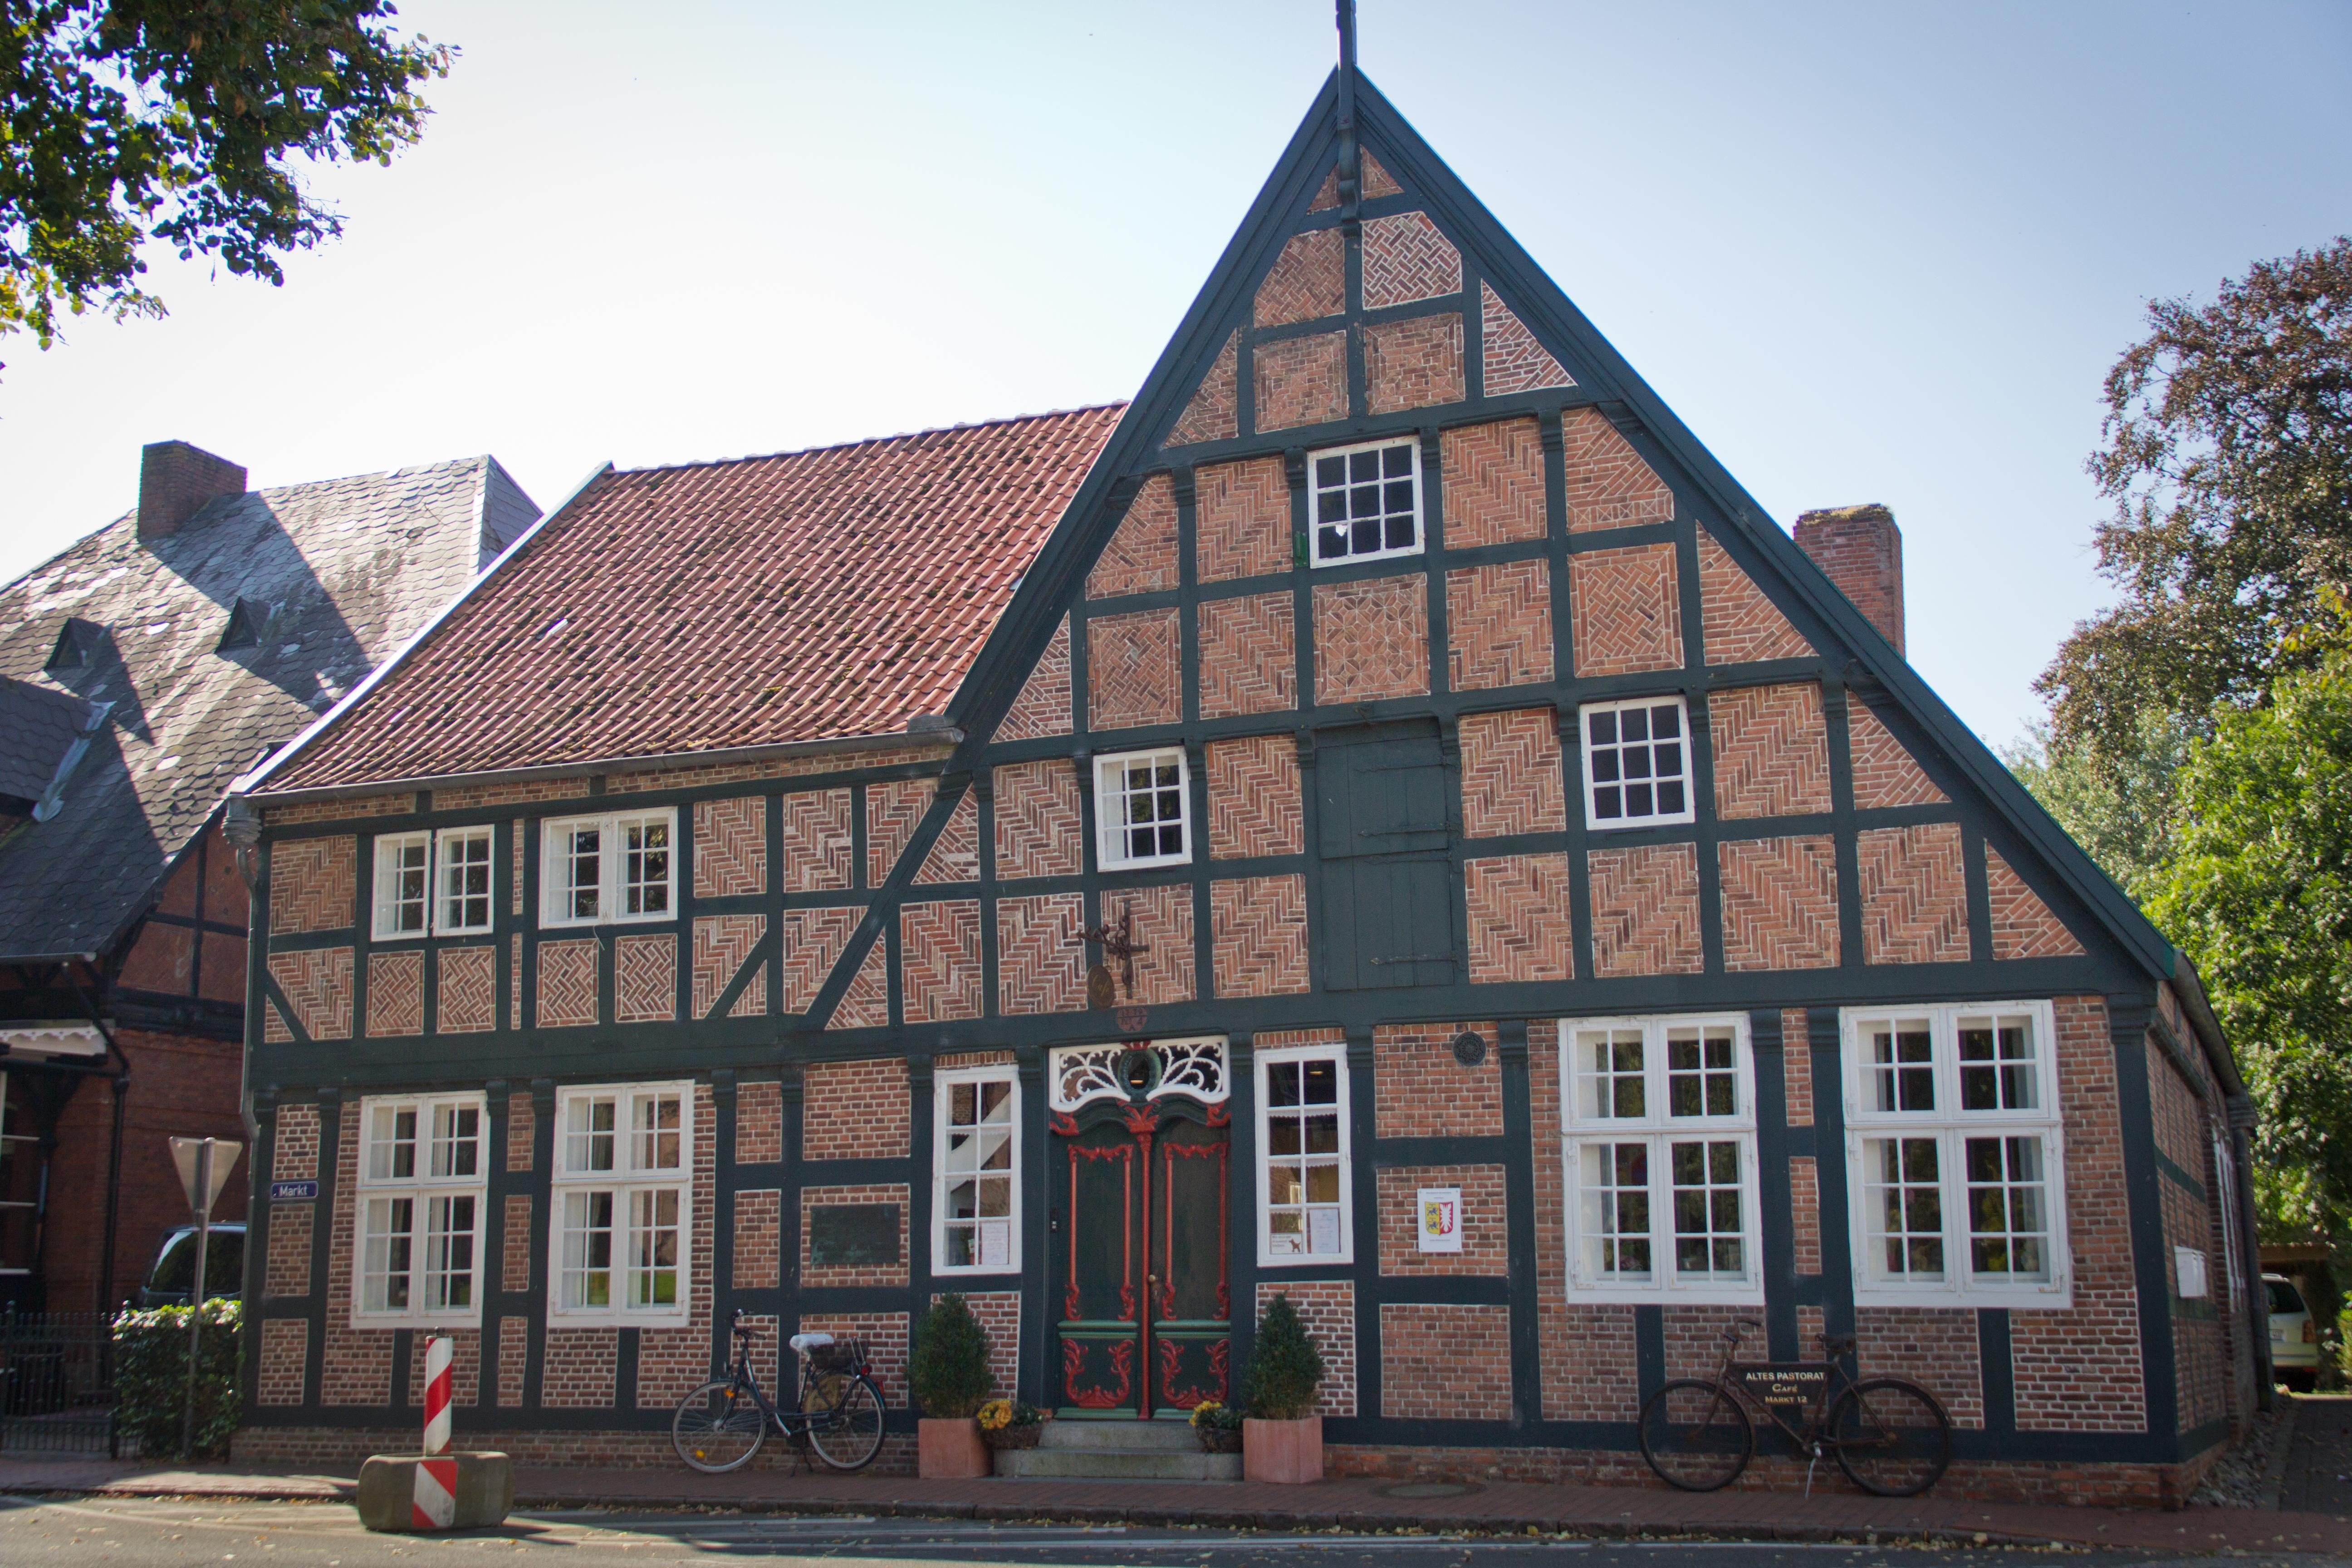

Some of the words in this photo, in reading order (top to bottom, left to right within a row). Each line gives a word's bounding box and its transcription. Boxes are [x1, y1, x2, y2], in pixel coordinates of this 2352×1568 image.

[280, 1185, 308, 1196] Markt
[1746, 1372, 1774, 1380] ALTES
[1777, 1372, 1824, 1380] PASTORAT
